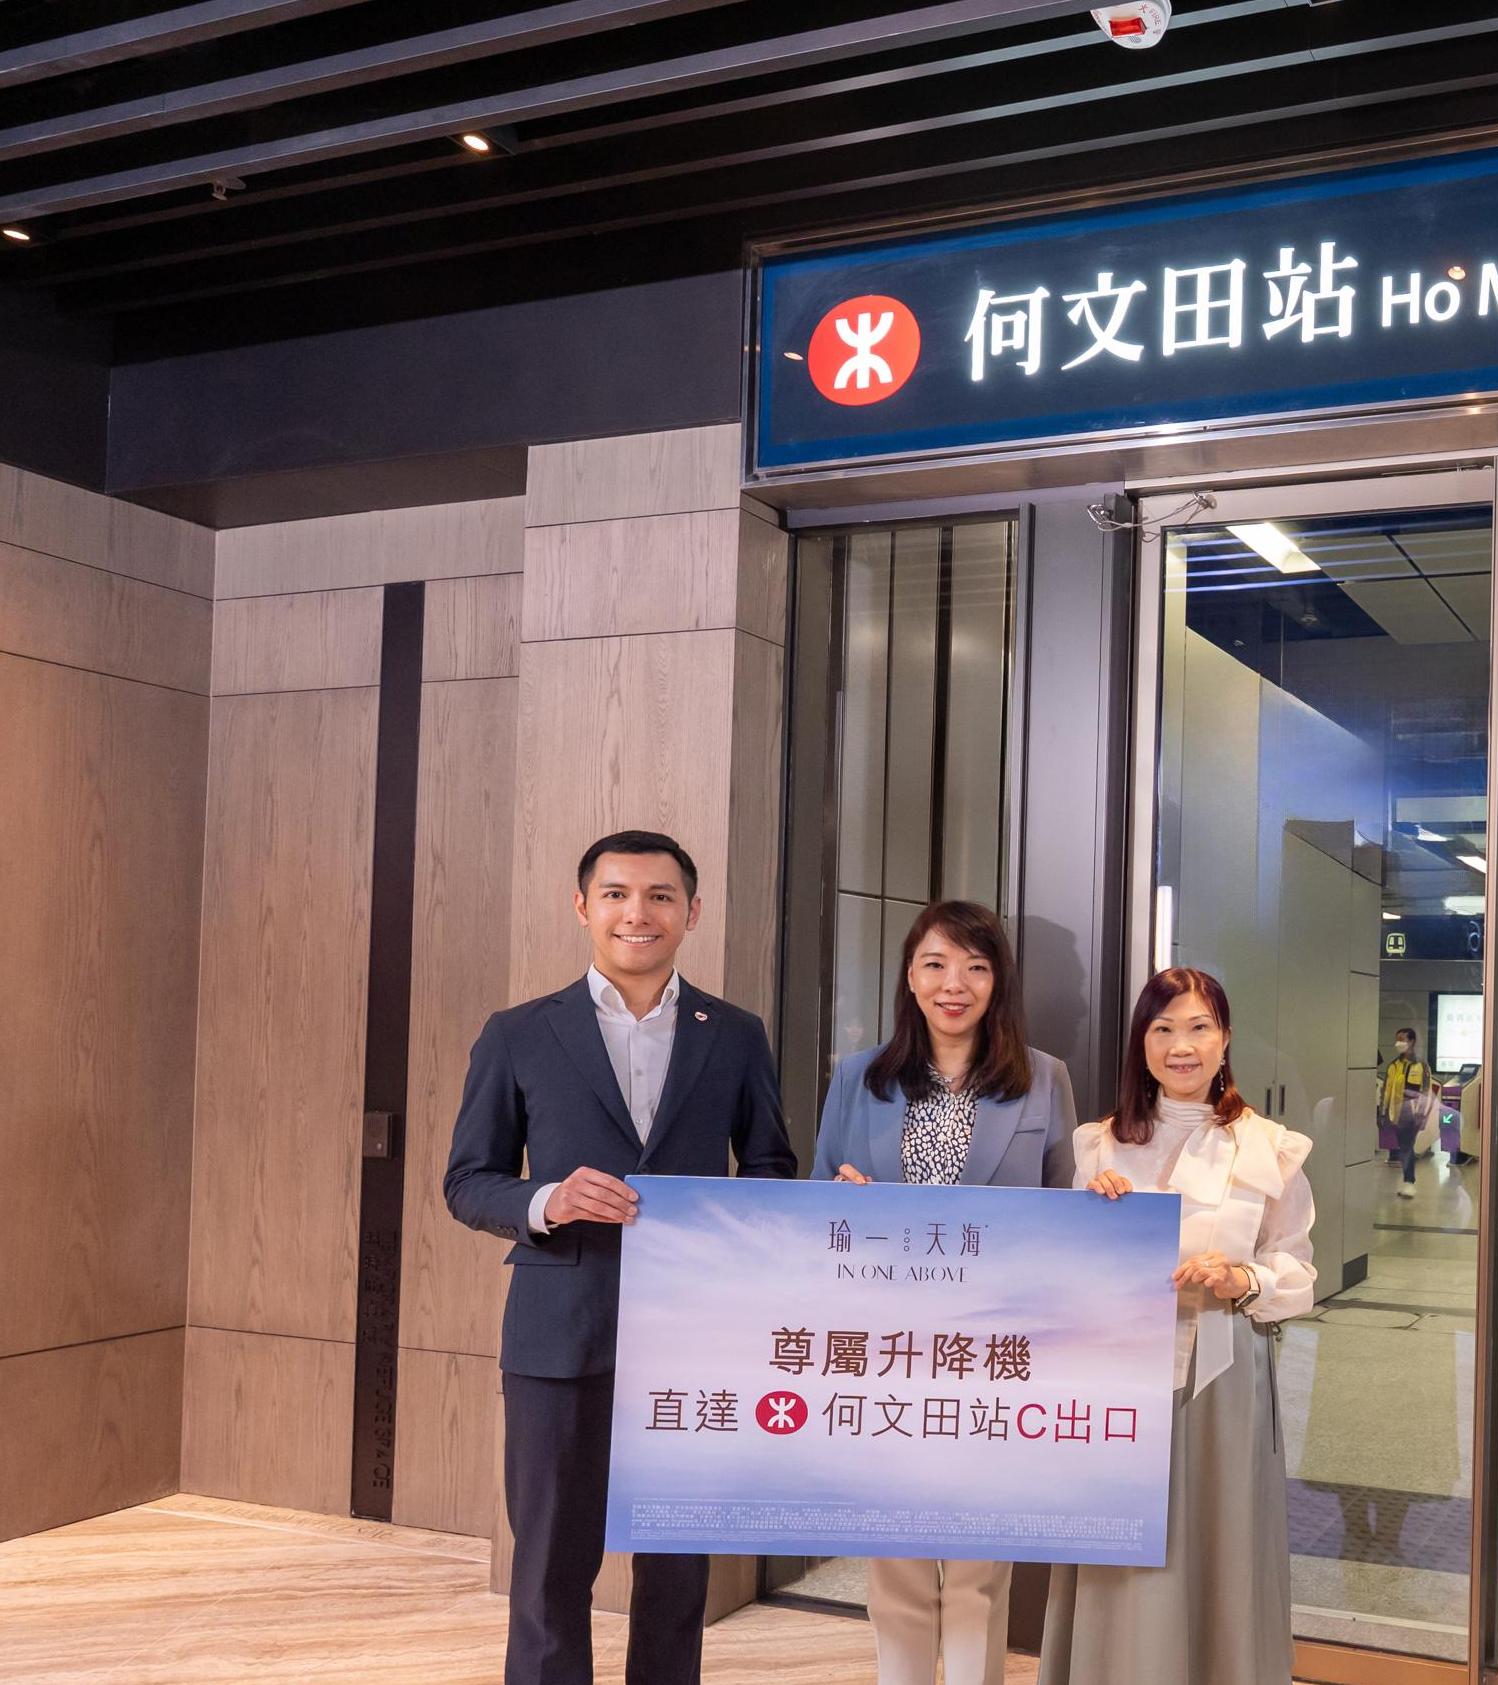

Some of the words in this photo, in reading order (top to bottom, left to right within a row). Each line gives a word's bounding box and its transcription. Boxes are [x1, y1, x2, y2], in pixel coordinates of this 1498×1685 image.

[963, 241, 1359, 382] 何文田站
[1381, 272, 1460, 328] Ho
[827, 1218, 889, 1253] 瑜一
[925, 1222, 981, 1257] 天海
[837, 1263, 855, 1279] IN
[861, 1264, 897, 1281] ONE
[905, 1266, 969, 1283] ABOVE
[768, 1327, 1032, 1382] 尊屬升降機
[645, 1389, 740, 1435] 直達
[821, 1392, 1138, 1444] 何文田站C出口
